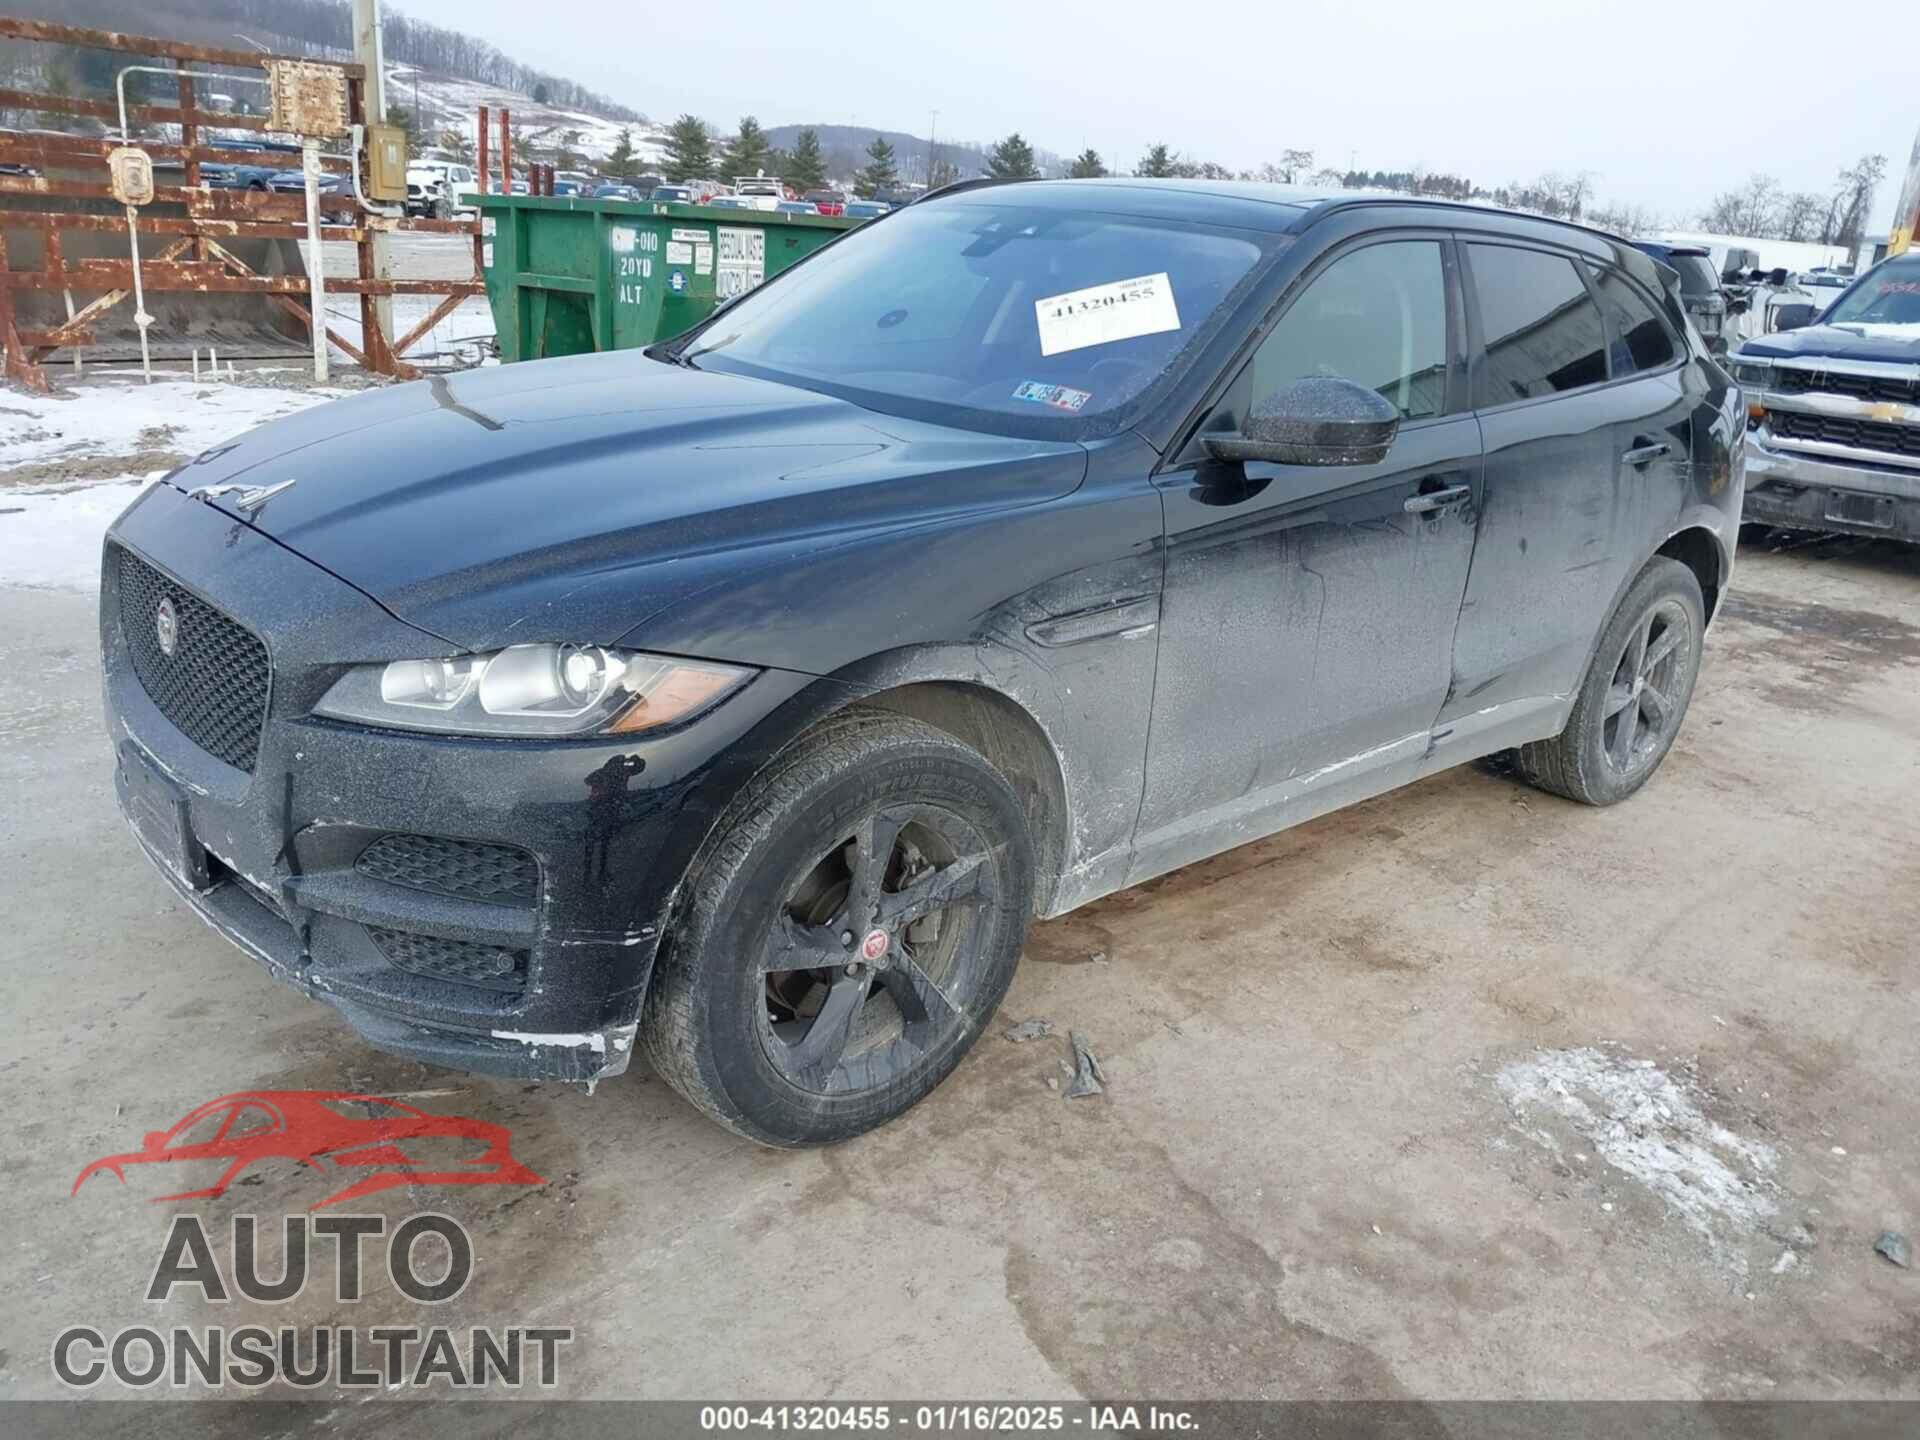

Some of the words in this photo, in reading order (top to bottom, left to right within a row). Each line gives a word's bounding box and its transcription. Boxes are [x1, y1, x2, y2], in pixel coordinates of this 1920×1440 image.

[620, 257, 652, 278] 20YD
[619, 284, 642, 304] ALT
[1051, 287, 1155, 317] 41320455
